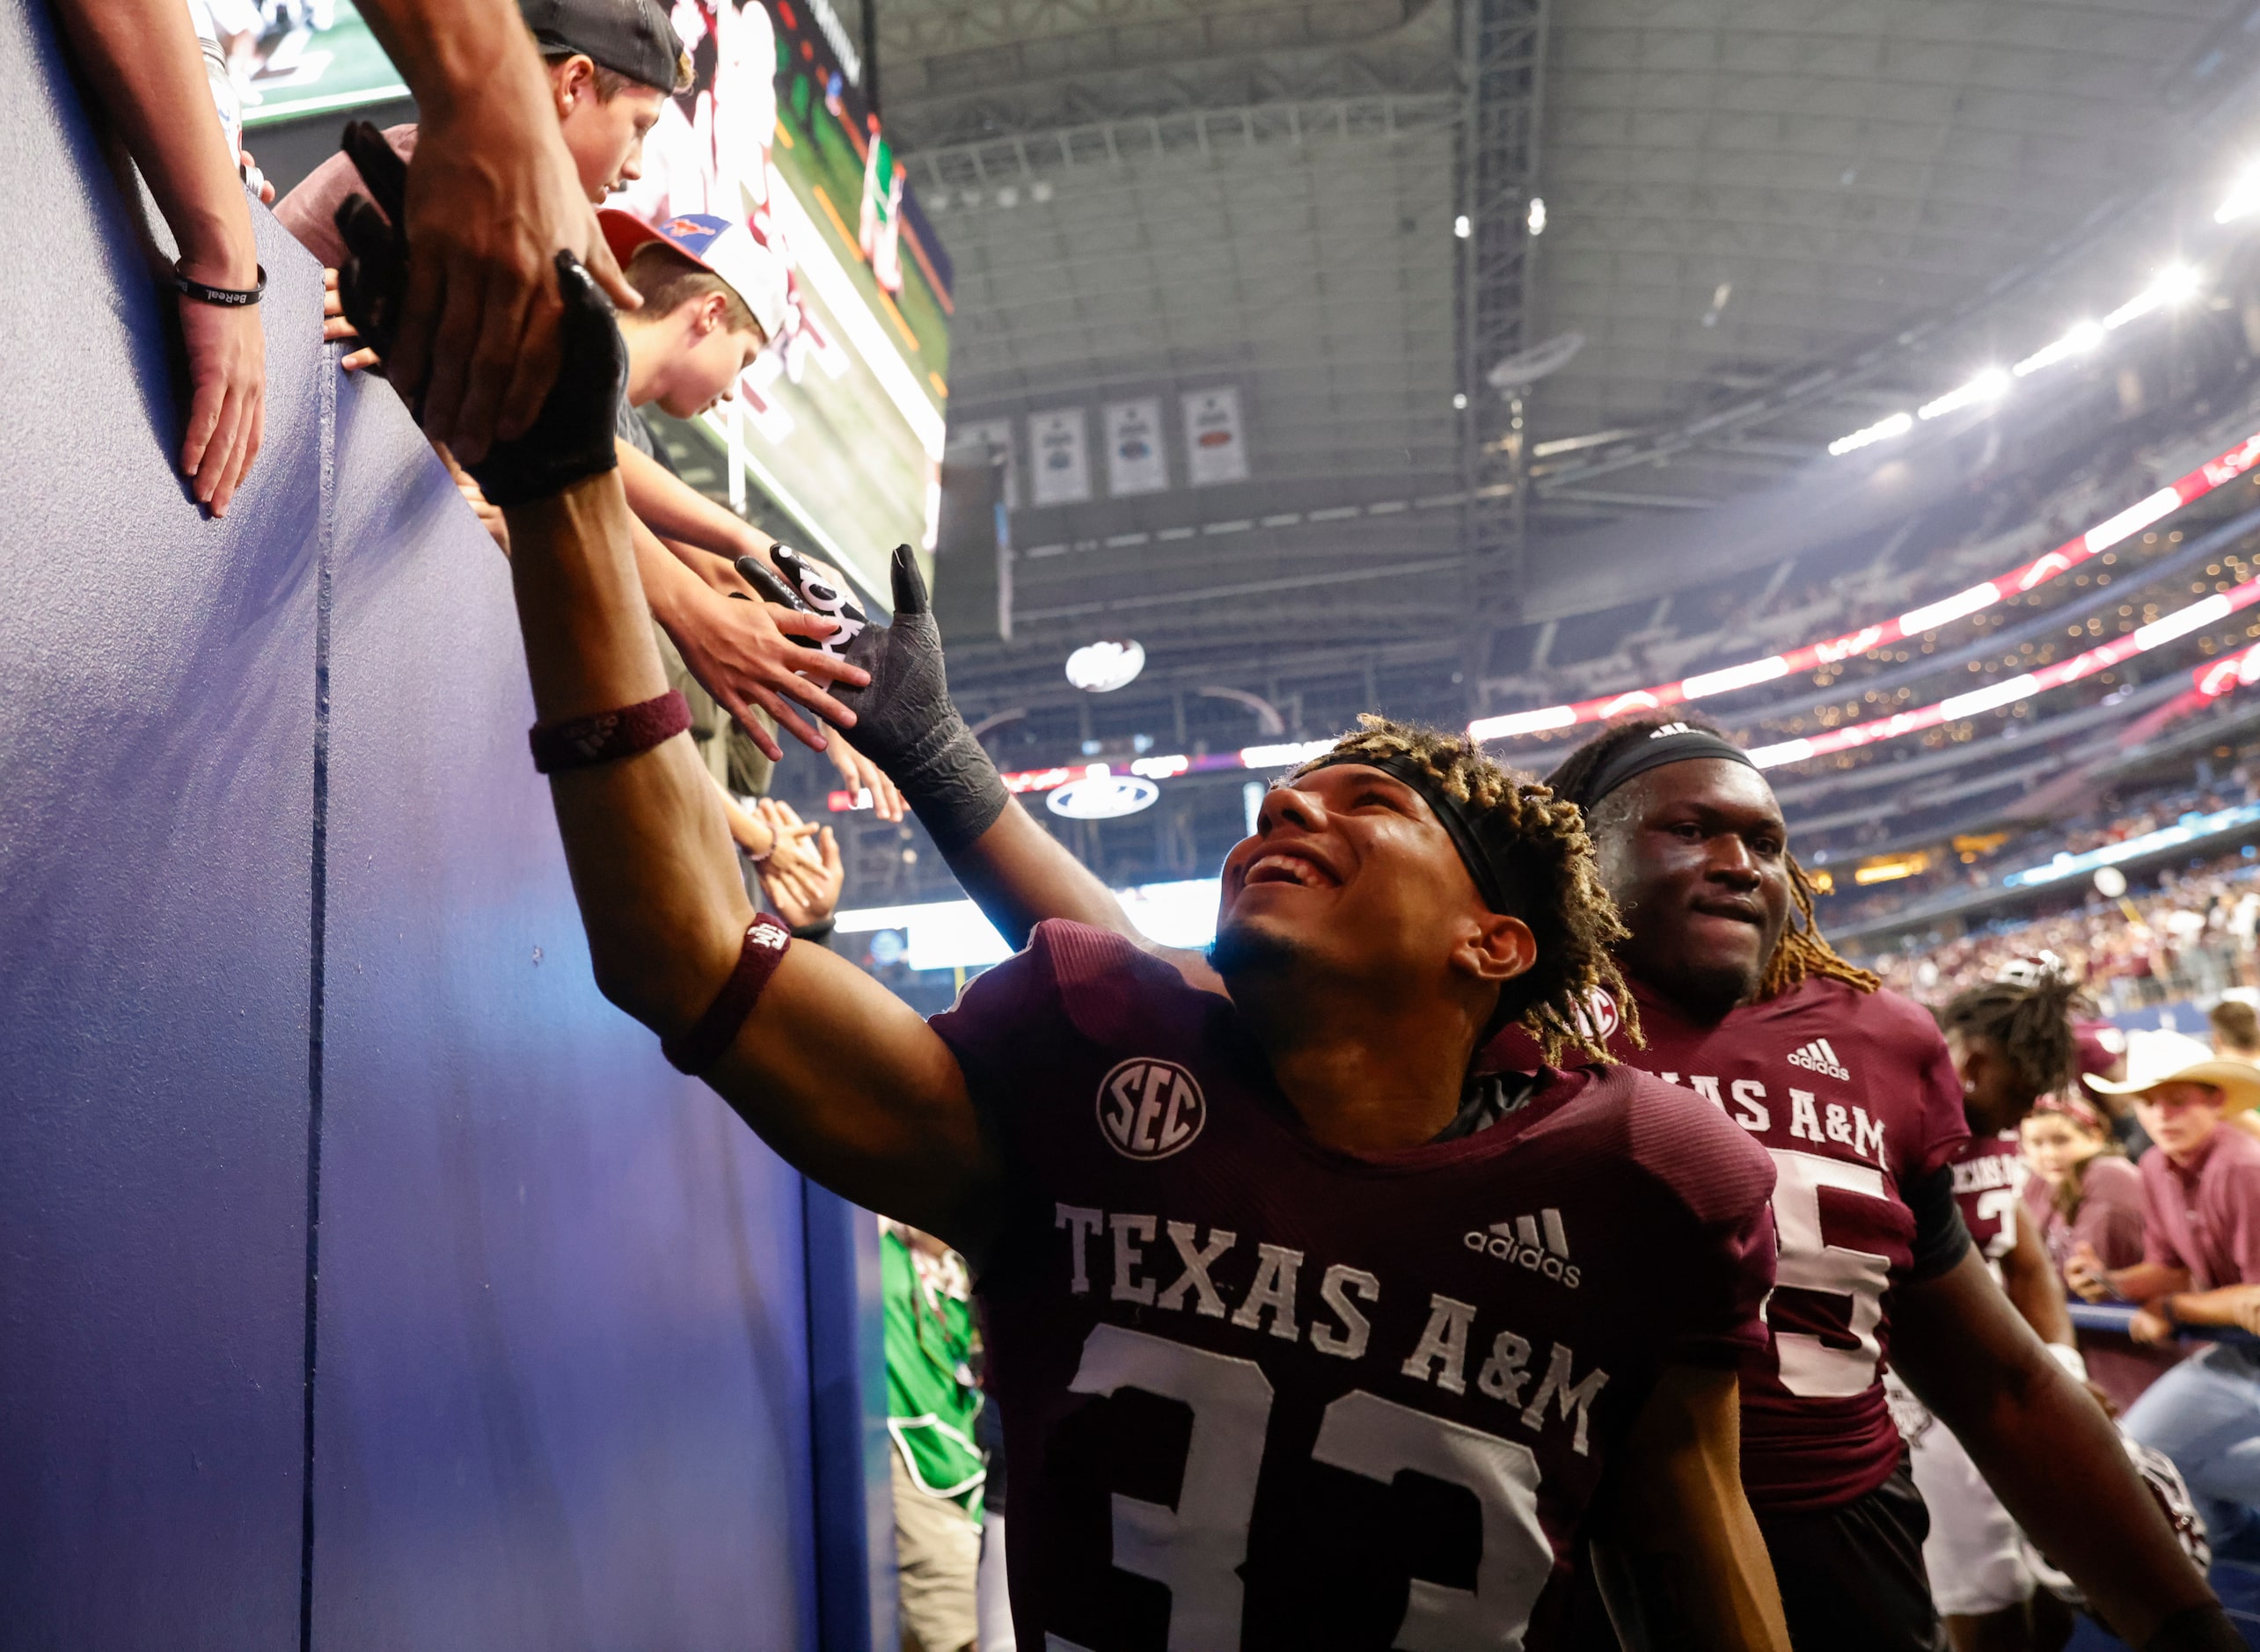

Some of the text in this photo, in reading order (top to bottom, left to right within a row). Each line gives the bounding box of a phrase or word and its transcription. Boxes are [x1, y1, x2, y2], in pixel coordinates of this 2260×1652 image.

[1106, 1064, 1196, 1151] SEC
[1787, 1053, 1850, 1081] adidas
[1788, 1087, 1890, 1172] A&M
[1464, 1231, 1582, 1289] adidas
[1056, 1202, 1610, 1457] TEXAS A&M
[1044, 1321, 1555, 1652] 33
